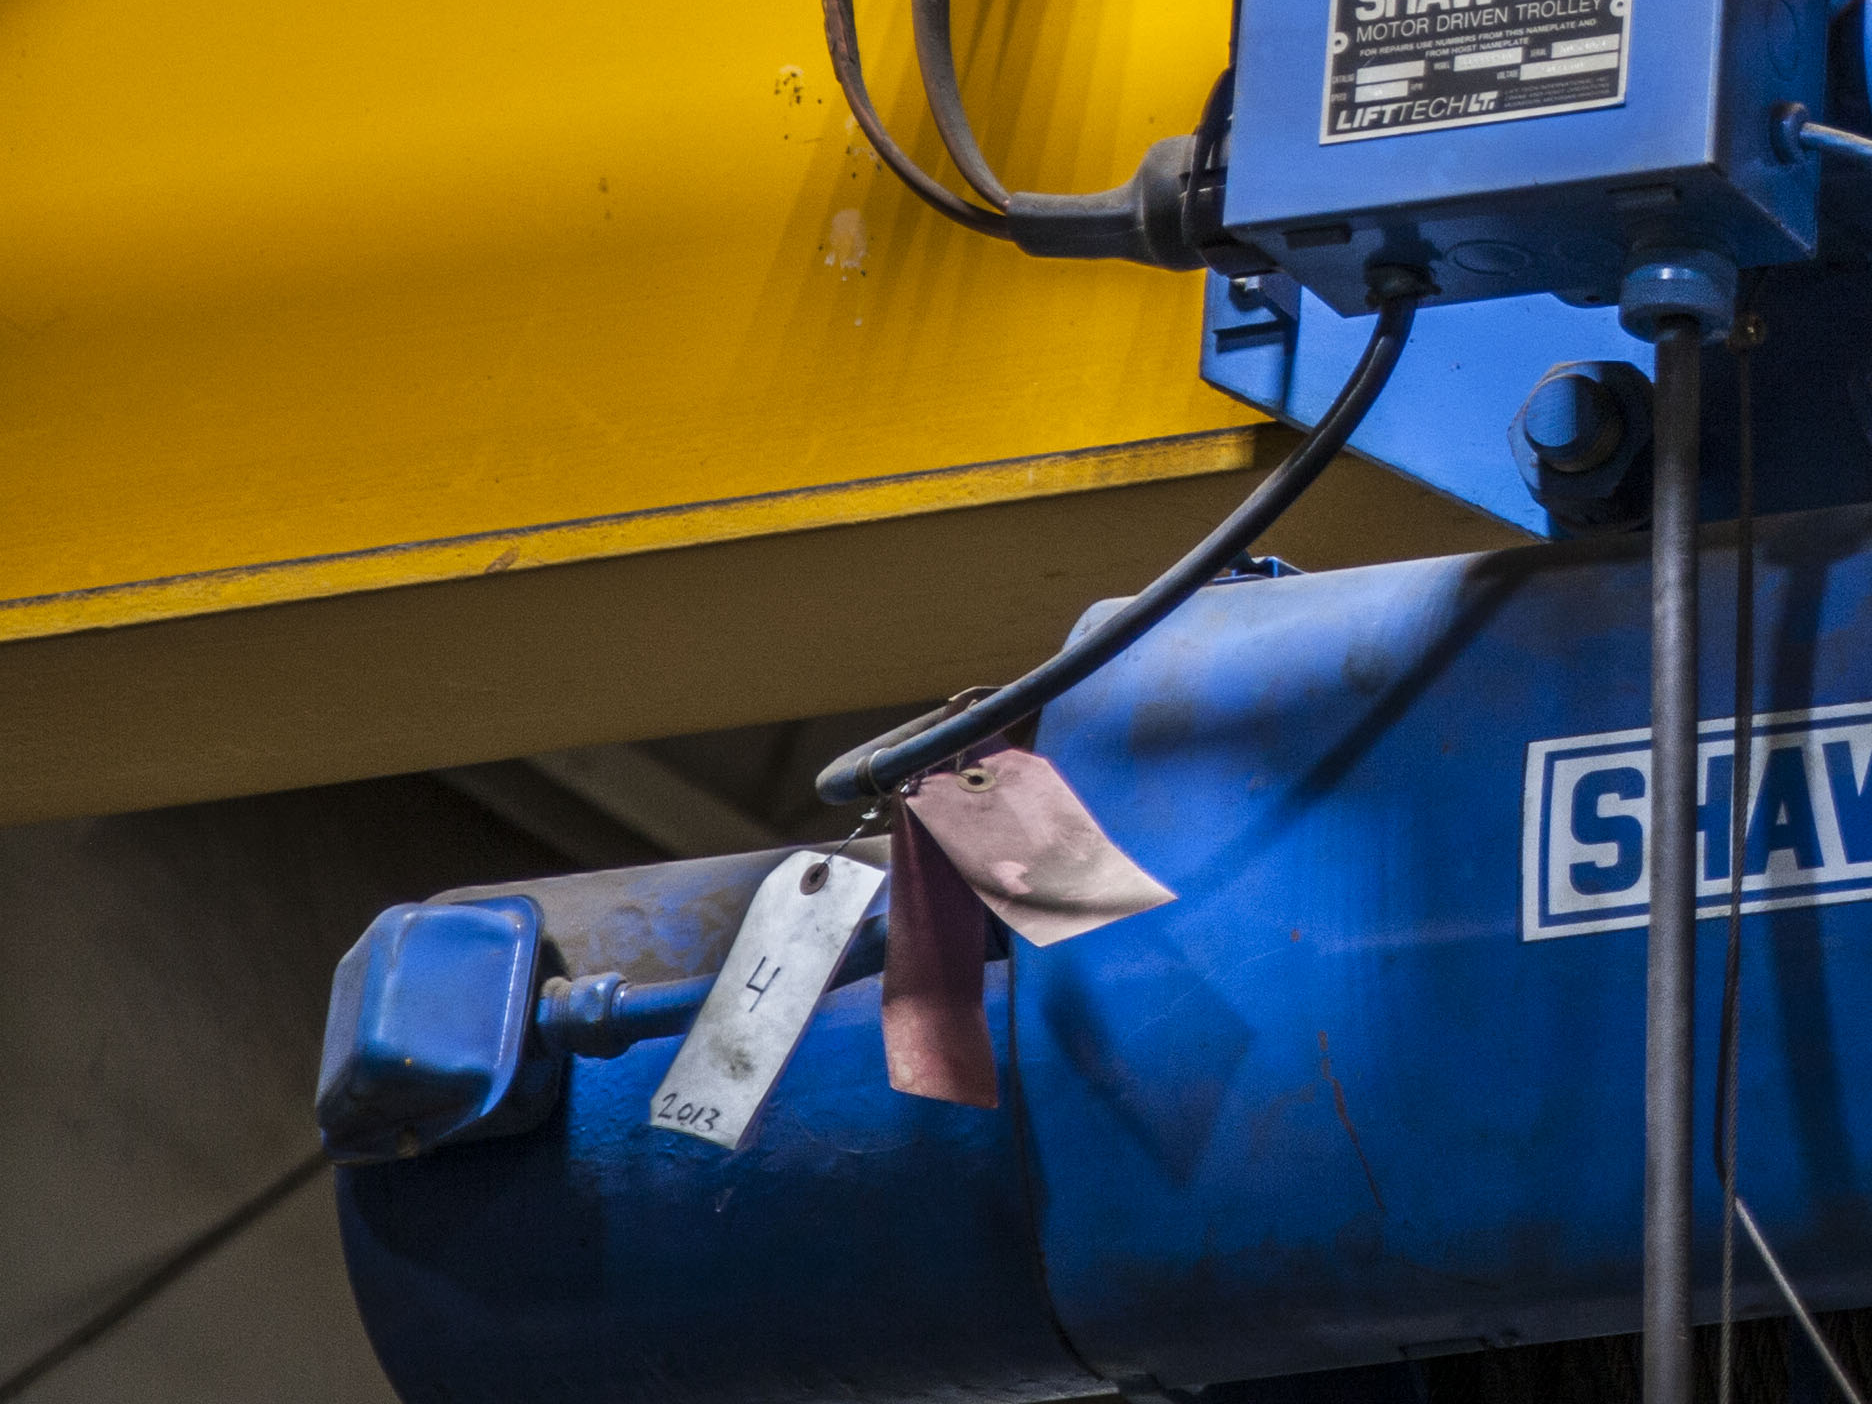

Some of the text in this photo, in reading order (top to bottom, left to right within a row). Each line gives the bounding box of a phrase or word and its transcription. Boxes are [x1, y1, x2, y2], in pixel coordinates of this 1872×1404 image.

[1356, 16, 1429, 43] MOTOR
[1437, 6, 1508, 33] DRIVEN
[746, 956, 781, 1012] 4
[657, 1092, 721, 1130] 2013
